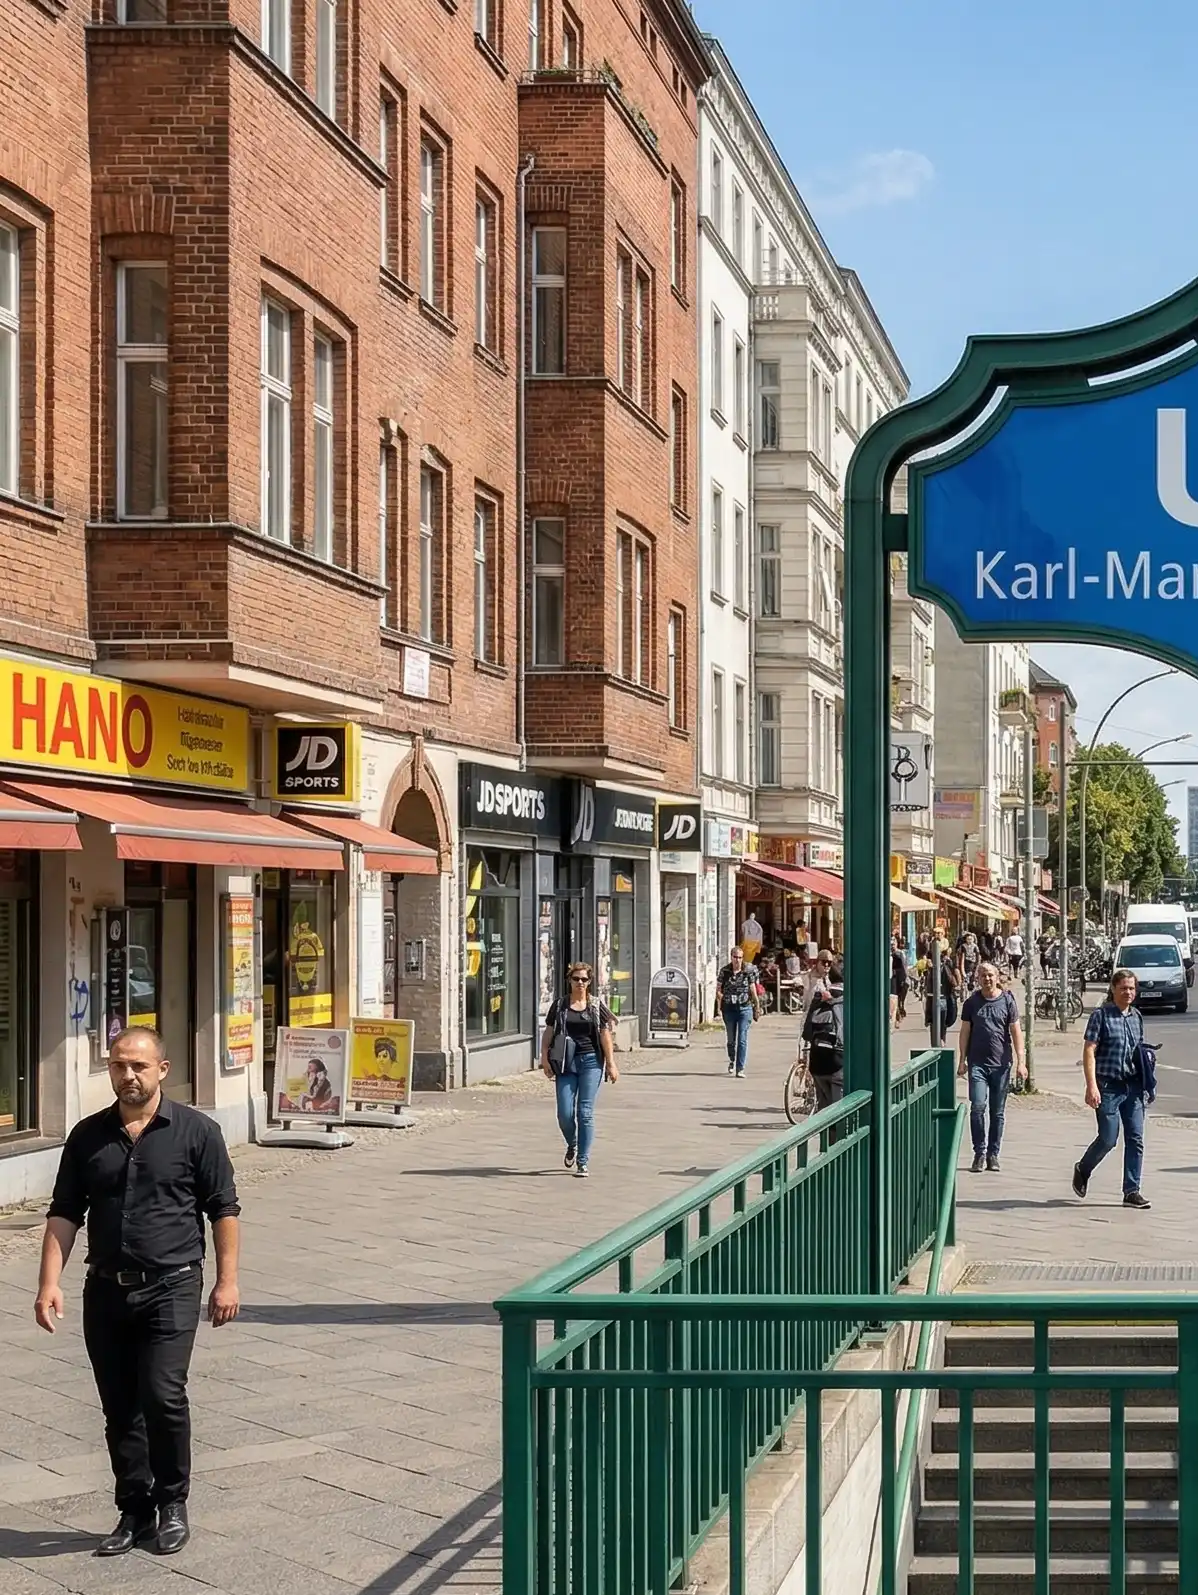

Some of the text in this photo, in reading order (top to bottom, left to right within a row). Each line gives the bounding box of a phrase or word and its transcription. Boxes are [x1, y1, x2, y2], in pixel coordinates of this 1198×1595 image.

[12, 672, 153, 769] HANO
[285, 736, 338, 772] JD
[285, 776, 340, 788] SPORTS
[571, 784, 596, 845] JD
[663, 815, 697, 840] JD
